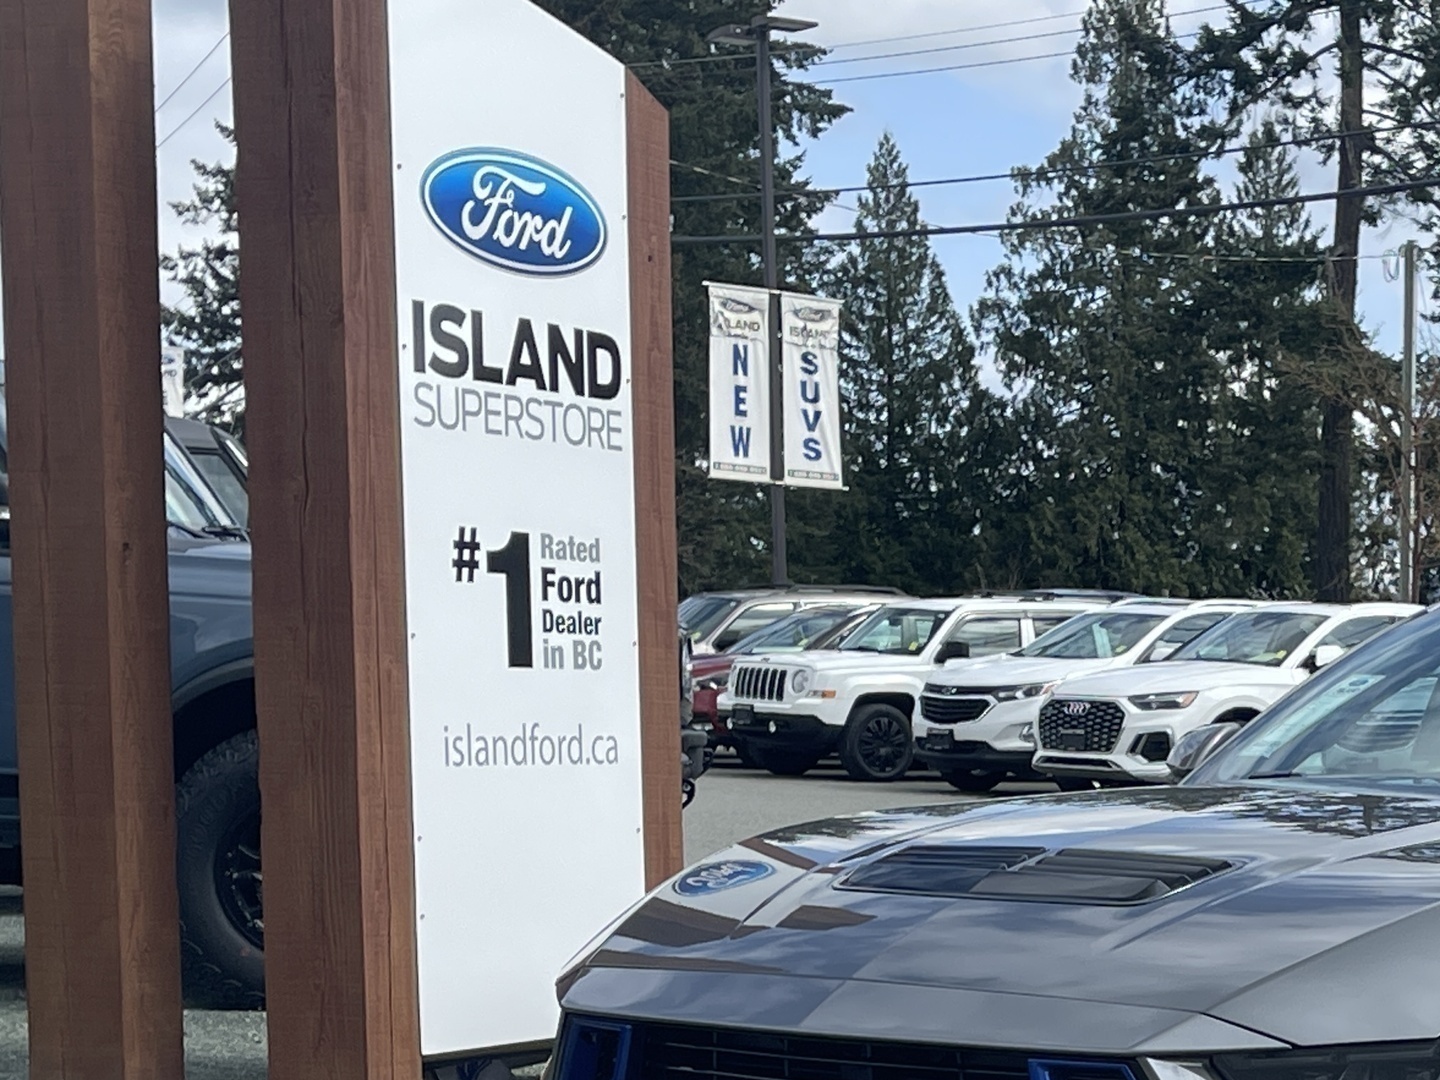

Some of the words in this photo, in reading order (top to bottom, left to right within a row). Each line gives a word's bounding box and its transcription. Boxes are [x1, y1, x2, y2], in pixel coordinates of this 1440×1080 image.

[461, 165, 573, 259] Ford
[411, 299, 622, 400] ISLAND
[413, 382, 623, 452] SUPERSTORE
[730, 343, 752, 459] NEW
[540, 532, 601, 563] Rated
[452, 525, 533, 668] #1
[541, 566, 602, 605] Ford
[542, 608, 602, 635] Dealer
[543, 639, 564, 669] in
[572, 639, 602, 670] BC
[443, 722, 619, 768] islandford.ca
